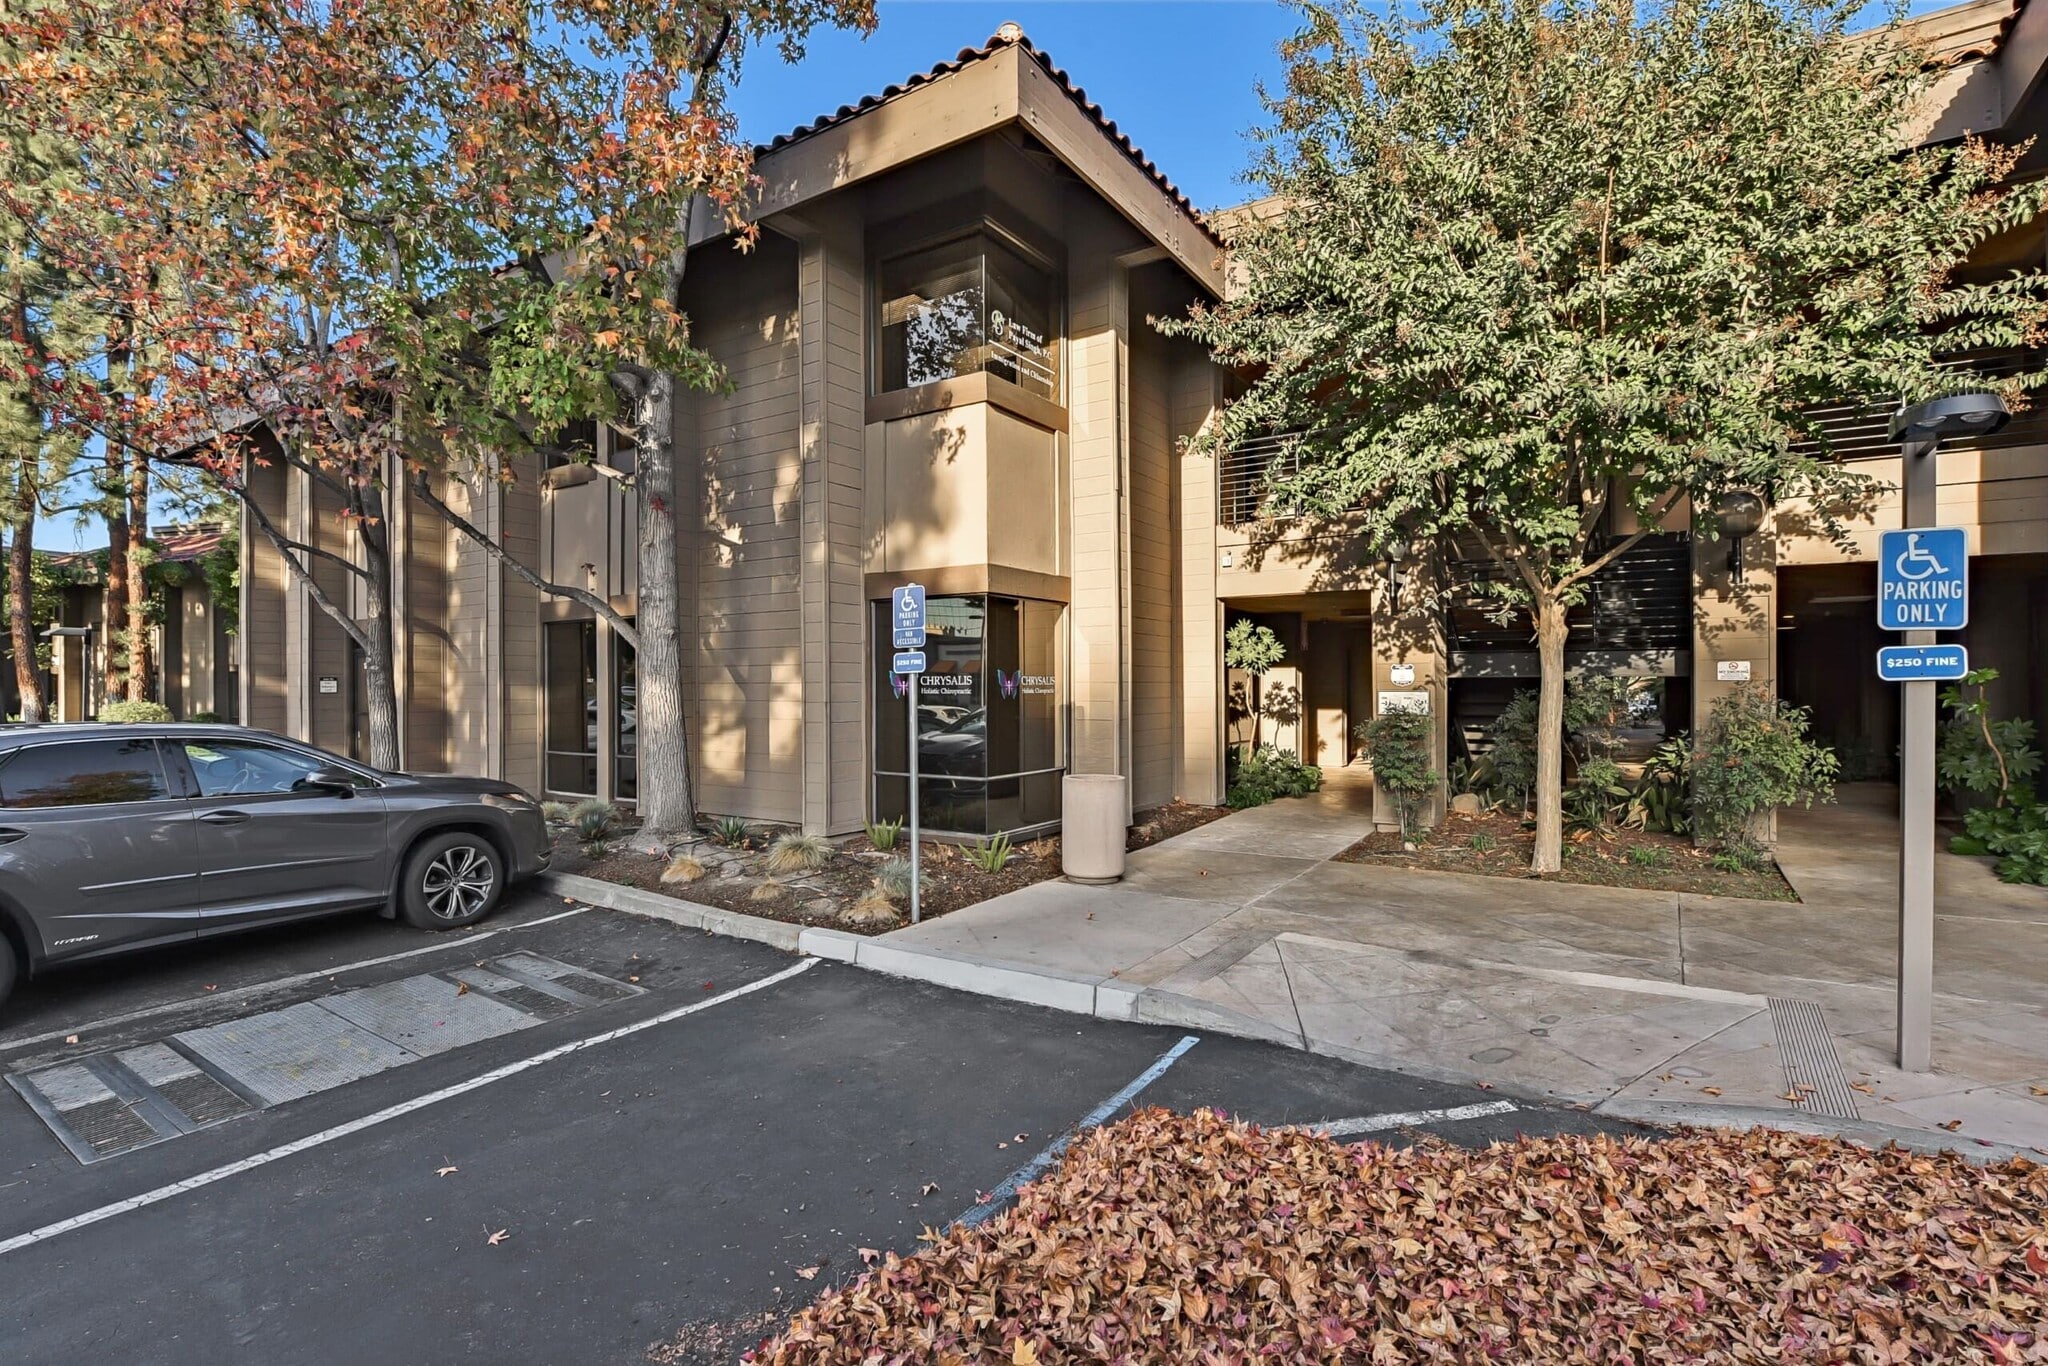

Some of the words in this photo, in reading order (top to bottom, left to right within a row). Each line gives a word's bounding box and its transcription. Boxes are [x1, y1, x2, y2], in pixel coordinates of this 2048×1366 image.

[1008, 317, 1021, 331] Law
[1022, 325, 1036, 340] Firm
[1036, 335, 1043, 344] of
[991, 351, 1021, 371] Immigration
[1021, 367, 1030, 376] and
[1883, 580, 1962, 600] PARKING
[898, 611, 920, 619] PARKING
[1897, 604, 1948, 622] ONLY
[902, 619, 916, 627] ONLY
[1886, 657, 1922, 668] $250
[1926, 656, 1959, 666] FINE
[920, 675, 973, 686] CHRYSALIS
[1020, 675, 1056, 686] CHRYSALIS
[940, 687, 973, 696] Chiropractic
[54, 934, 99, 946] HYBRID
